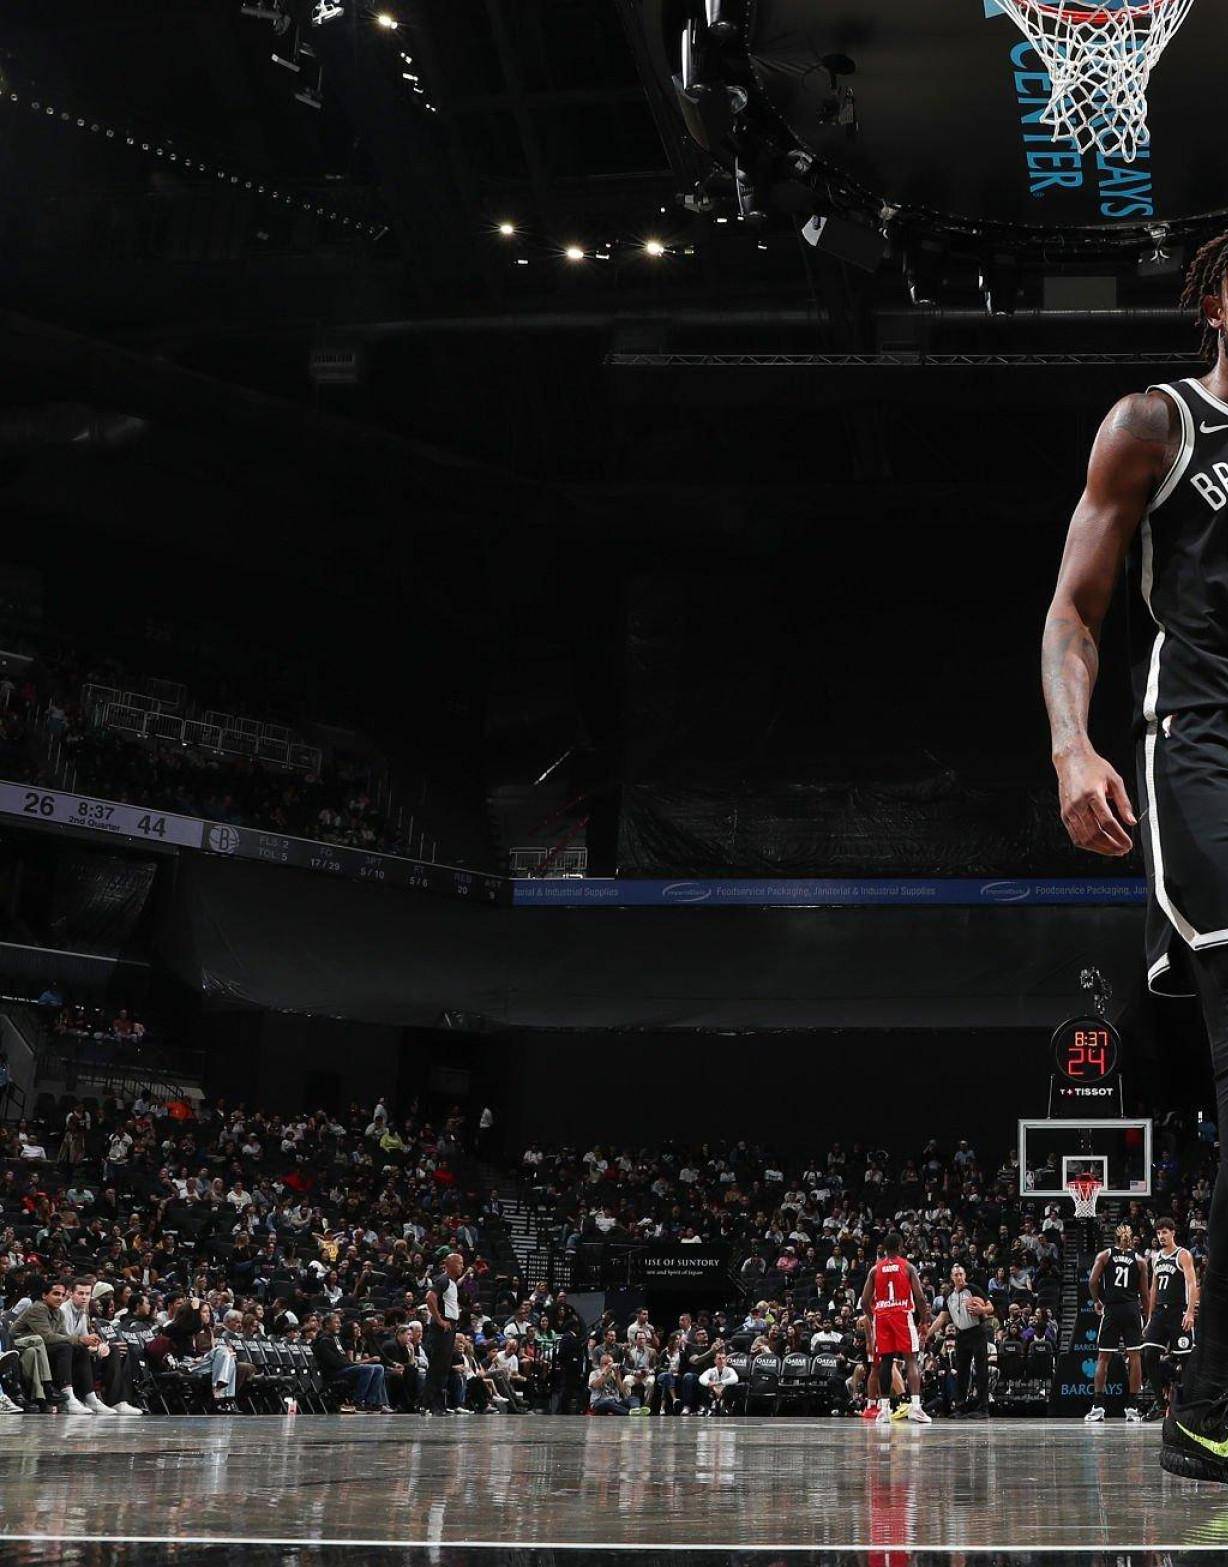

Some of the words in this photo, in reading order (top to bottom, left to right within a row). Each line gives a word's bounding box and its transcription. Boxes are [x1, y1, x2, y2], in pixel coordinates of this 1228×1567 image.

[1009, 40, 1083, 193] CENTER
[23, 792, 55, 816] 26
[77, 802, 114, 820] 8:37
[68, 816, 85, 825] 2nd
[88, 819, 120, 832] Quarter
[137, 815, 166, 837] 44
[716, 886, 765, 896] Foodservice
[861, 887, 899, 896] Industrial
[901, 887, 936, 897] Supplies
[1035, 886, 1085, 896] Foodservice
[1075, 1031, 1108, 1047] 8:37
[1068, 1048, 1105, 1075] 24
[1075, 1087, 1114, 1096] TISSOT
[663, 1258, 674, 1266] OF
[677, 1258, 720, 1266] SUNTORY
[1114, 1266, 1129, 1288] 21
[1158, 1275, 1169, 1291] 77
[887, 1281, 895, 1300] 1
[1061, 1384, 1123, 1396] BARCAYS
